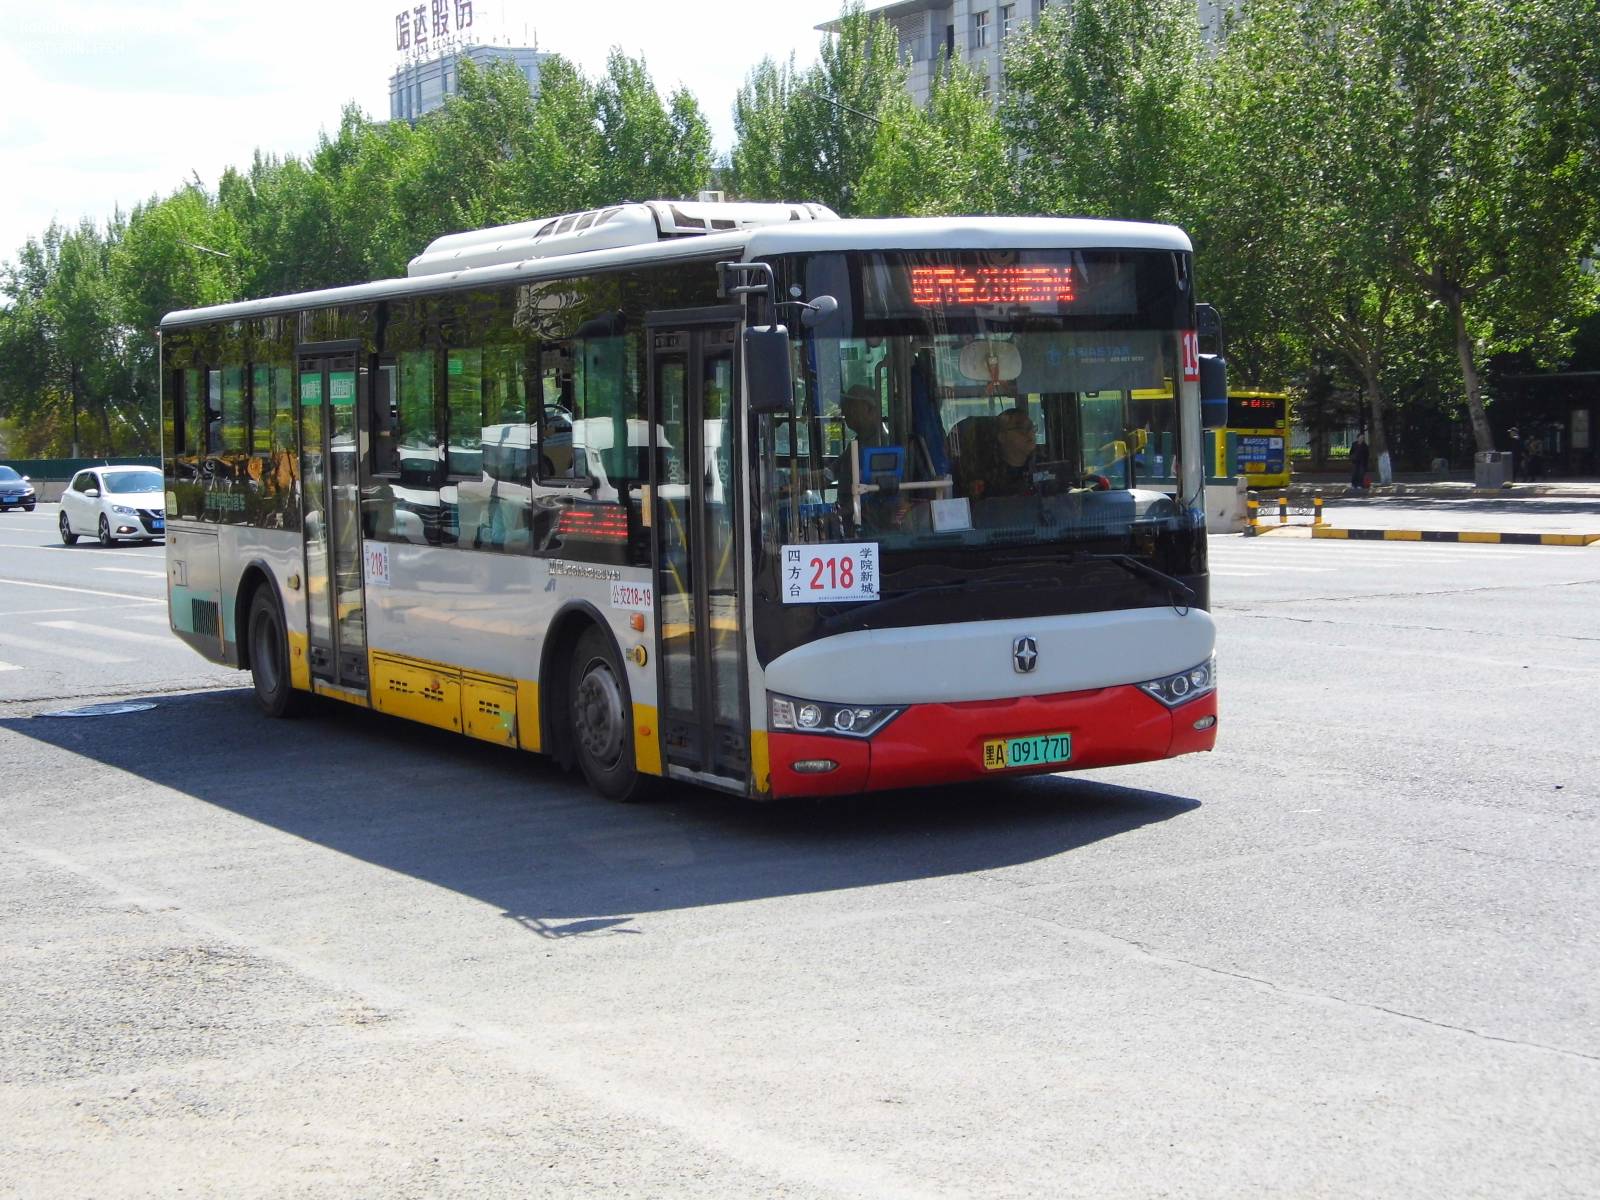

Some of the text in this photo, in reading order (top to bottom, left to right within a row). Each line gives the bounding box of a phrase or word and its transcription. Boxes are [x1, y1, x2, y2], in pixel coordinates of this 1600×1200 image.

[788, 550, 801, 597] 四方台
[810, 557, 854, 590] 218
[860, 547, 873, 593] 学院新城
